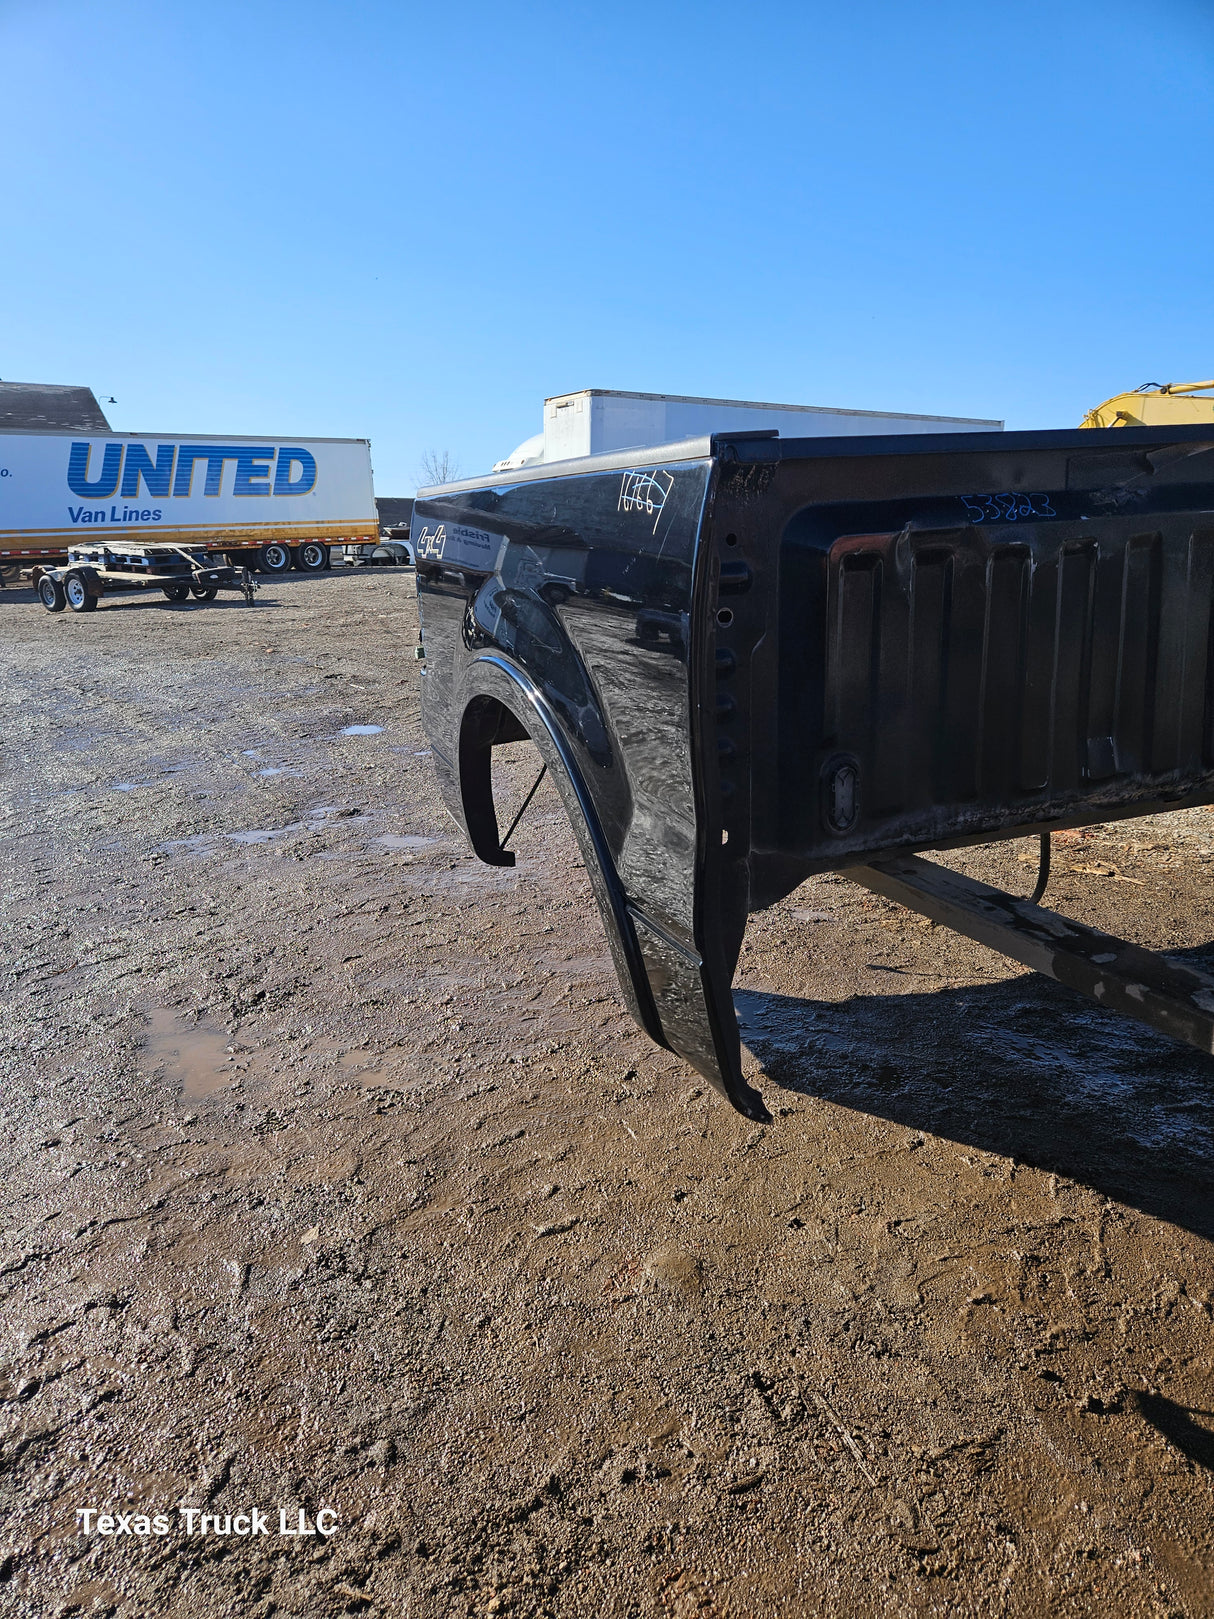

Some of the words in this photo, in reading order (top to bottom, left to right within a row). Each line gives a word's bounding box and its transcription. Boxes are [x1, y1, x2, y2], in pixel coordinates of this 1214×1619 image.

[67, 442, 318, 499] UNITED
[68, 506, 106, 523] Van
[110, 506, 162, 522] Lines
[961, 491, 1057, 523] 53823
